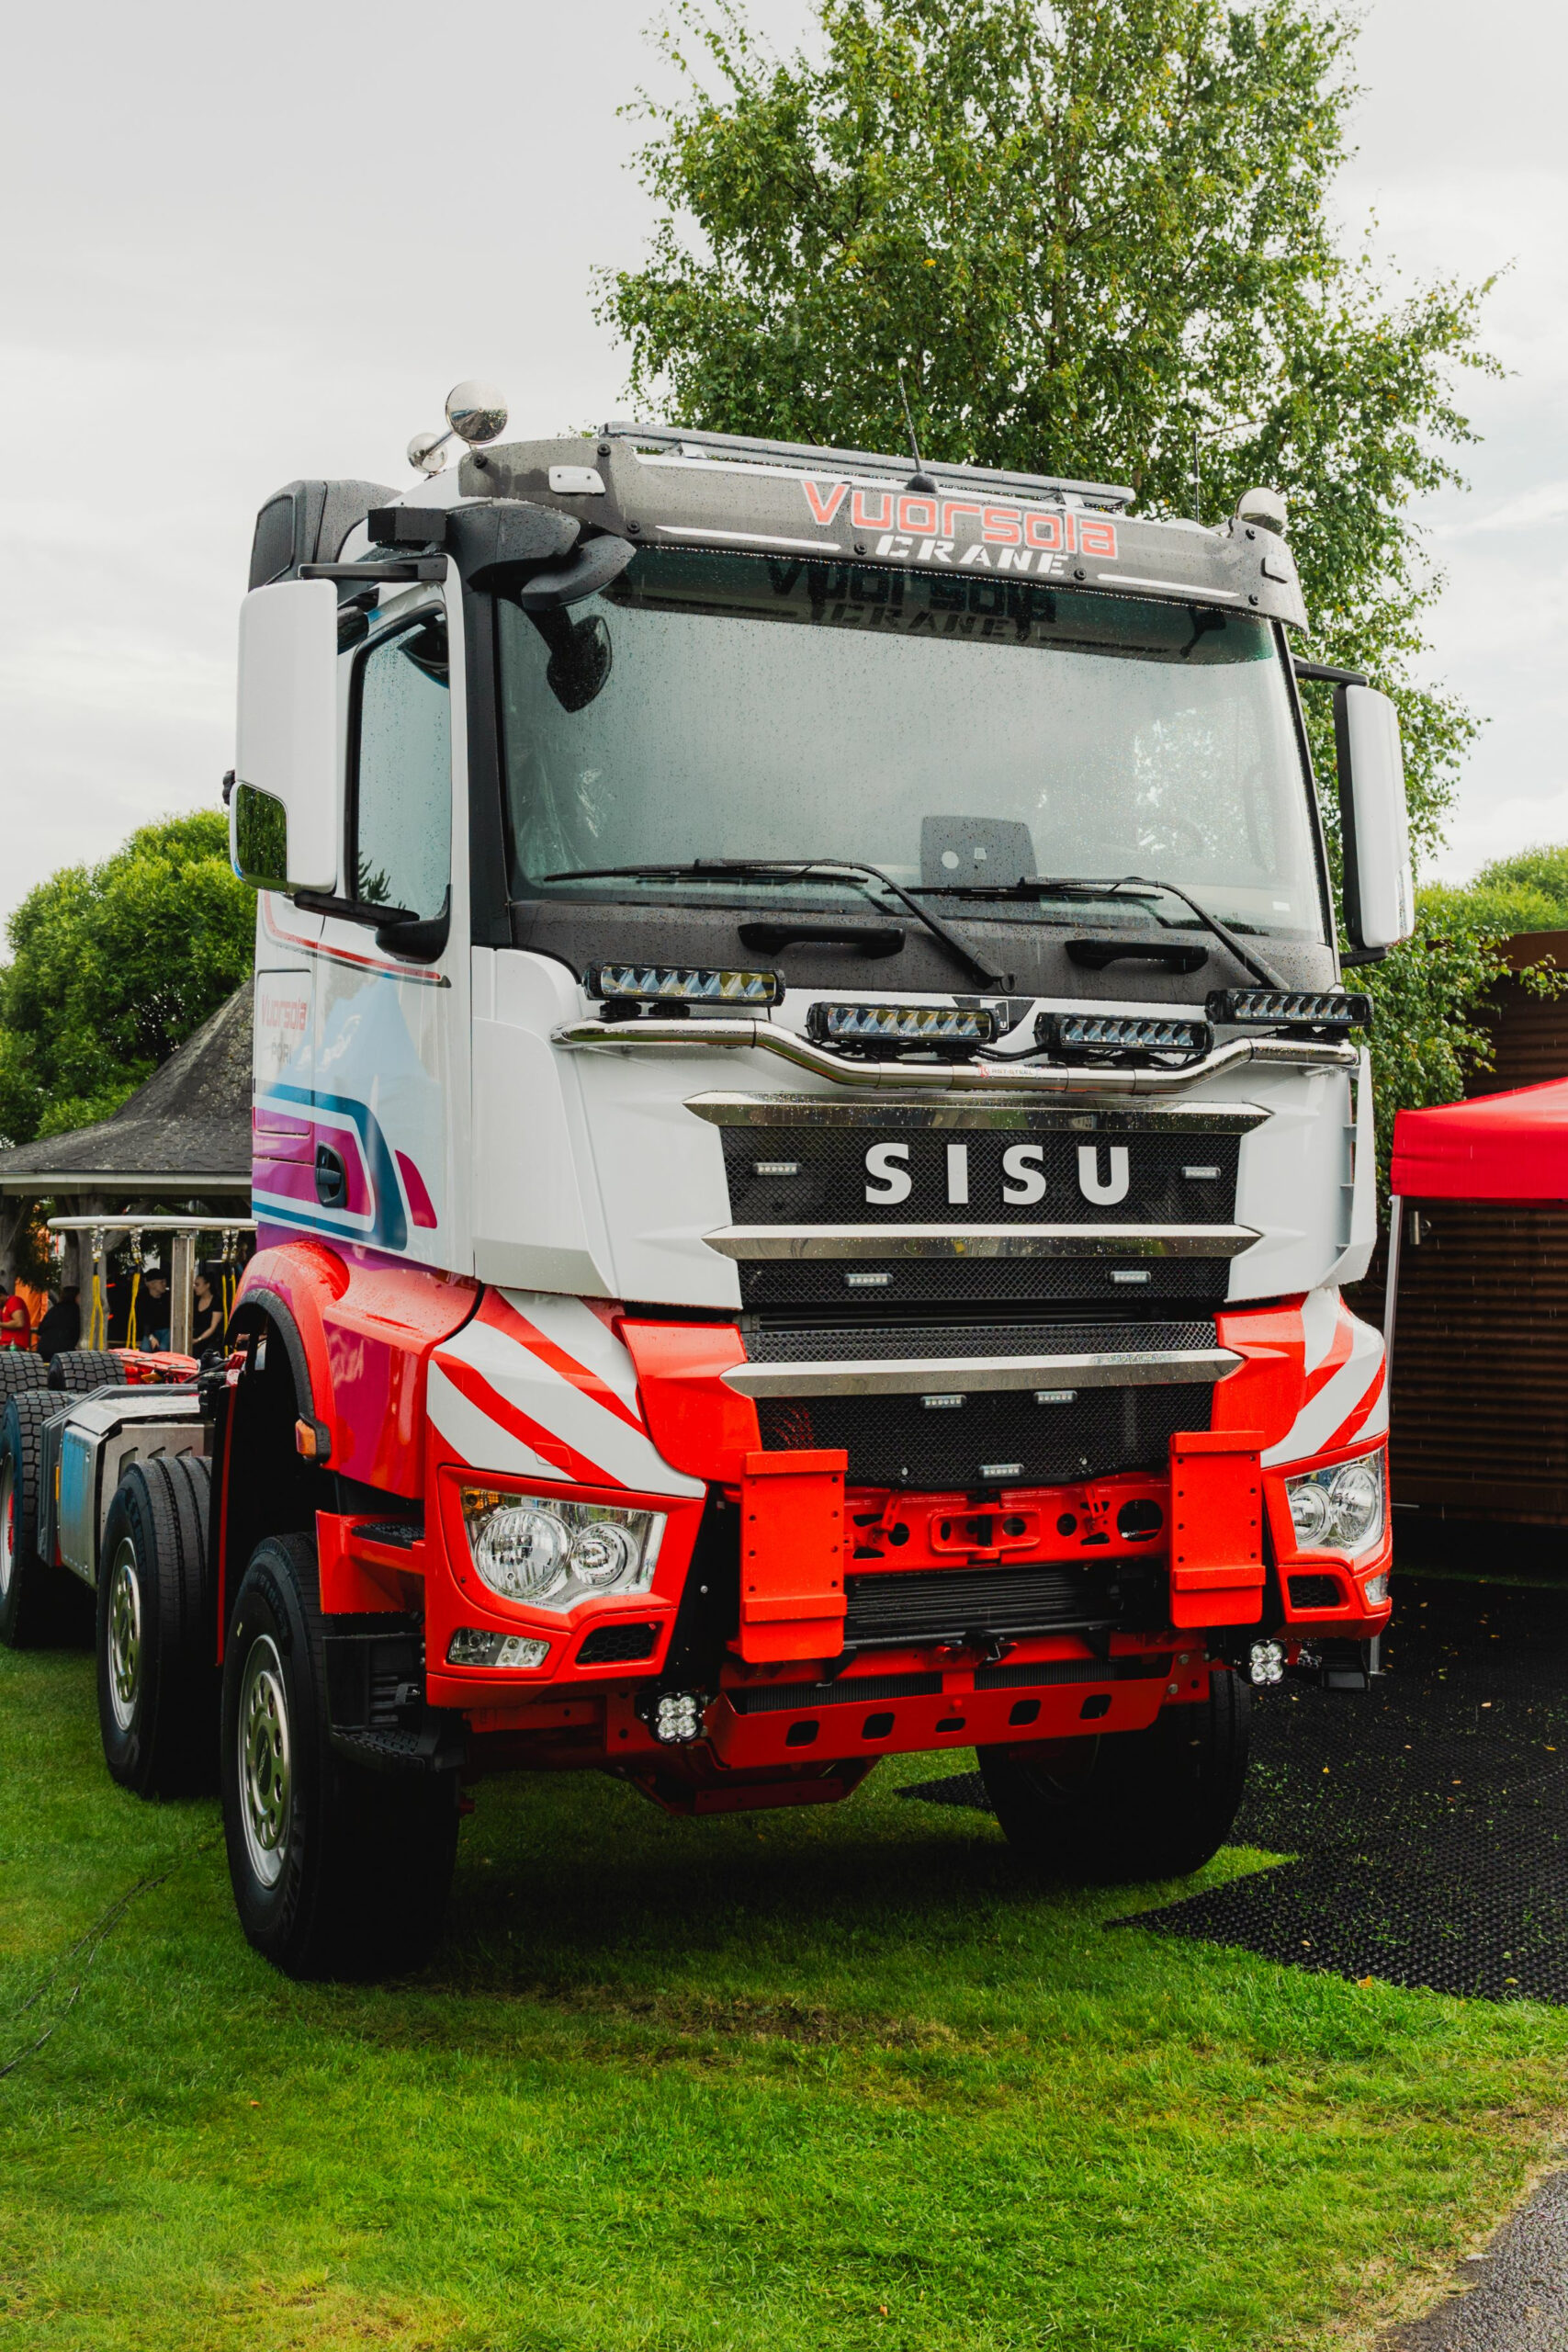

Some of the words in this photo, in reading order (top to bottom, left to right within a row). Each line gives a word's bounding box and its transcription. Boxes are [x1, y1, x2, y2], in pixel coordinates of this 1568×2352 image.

[800, 481, 1118, 560] Vuorsola
[875, 535, 1069, 575] CRANE
[262, 994, 307, 1030] Vuorsola
[865, 1142, 1130, 1205] SISU
